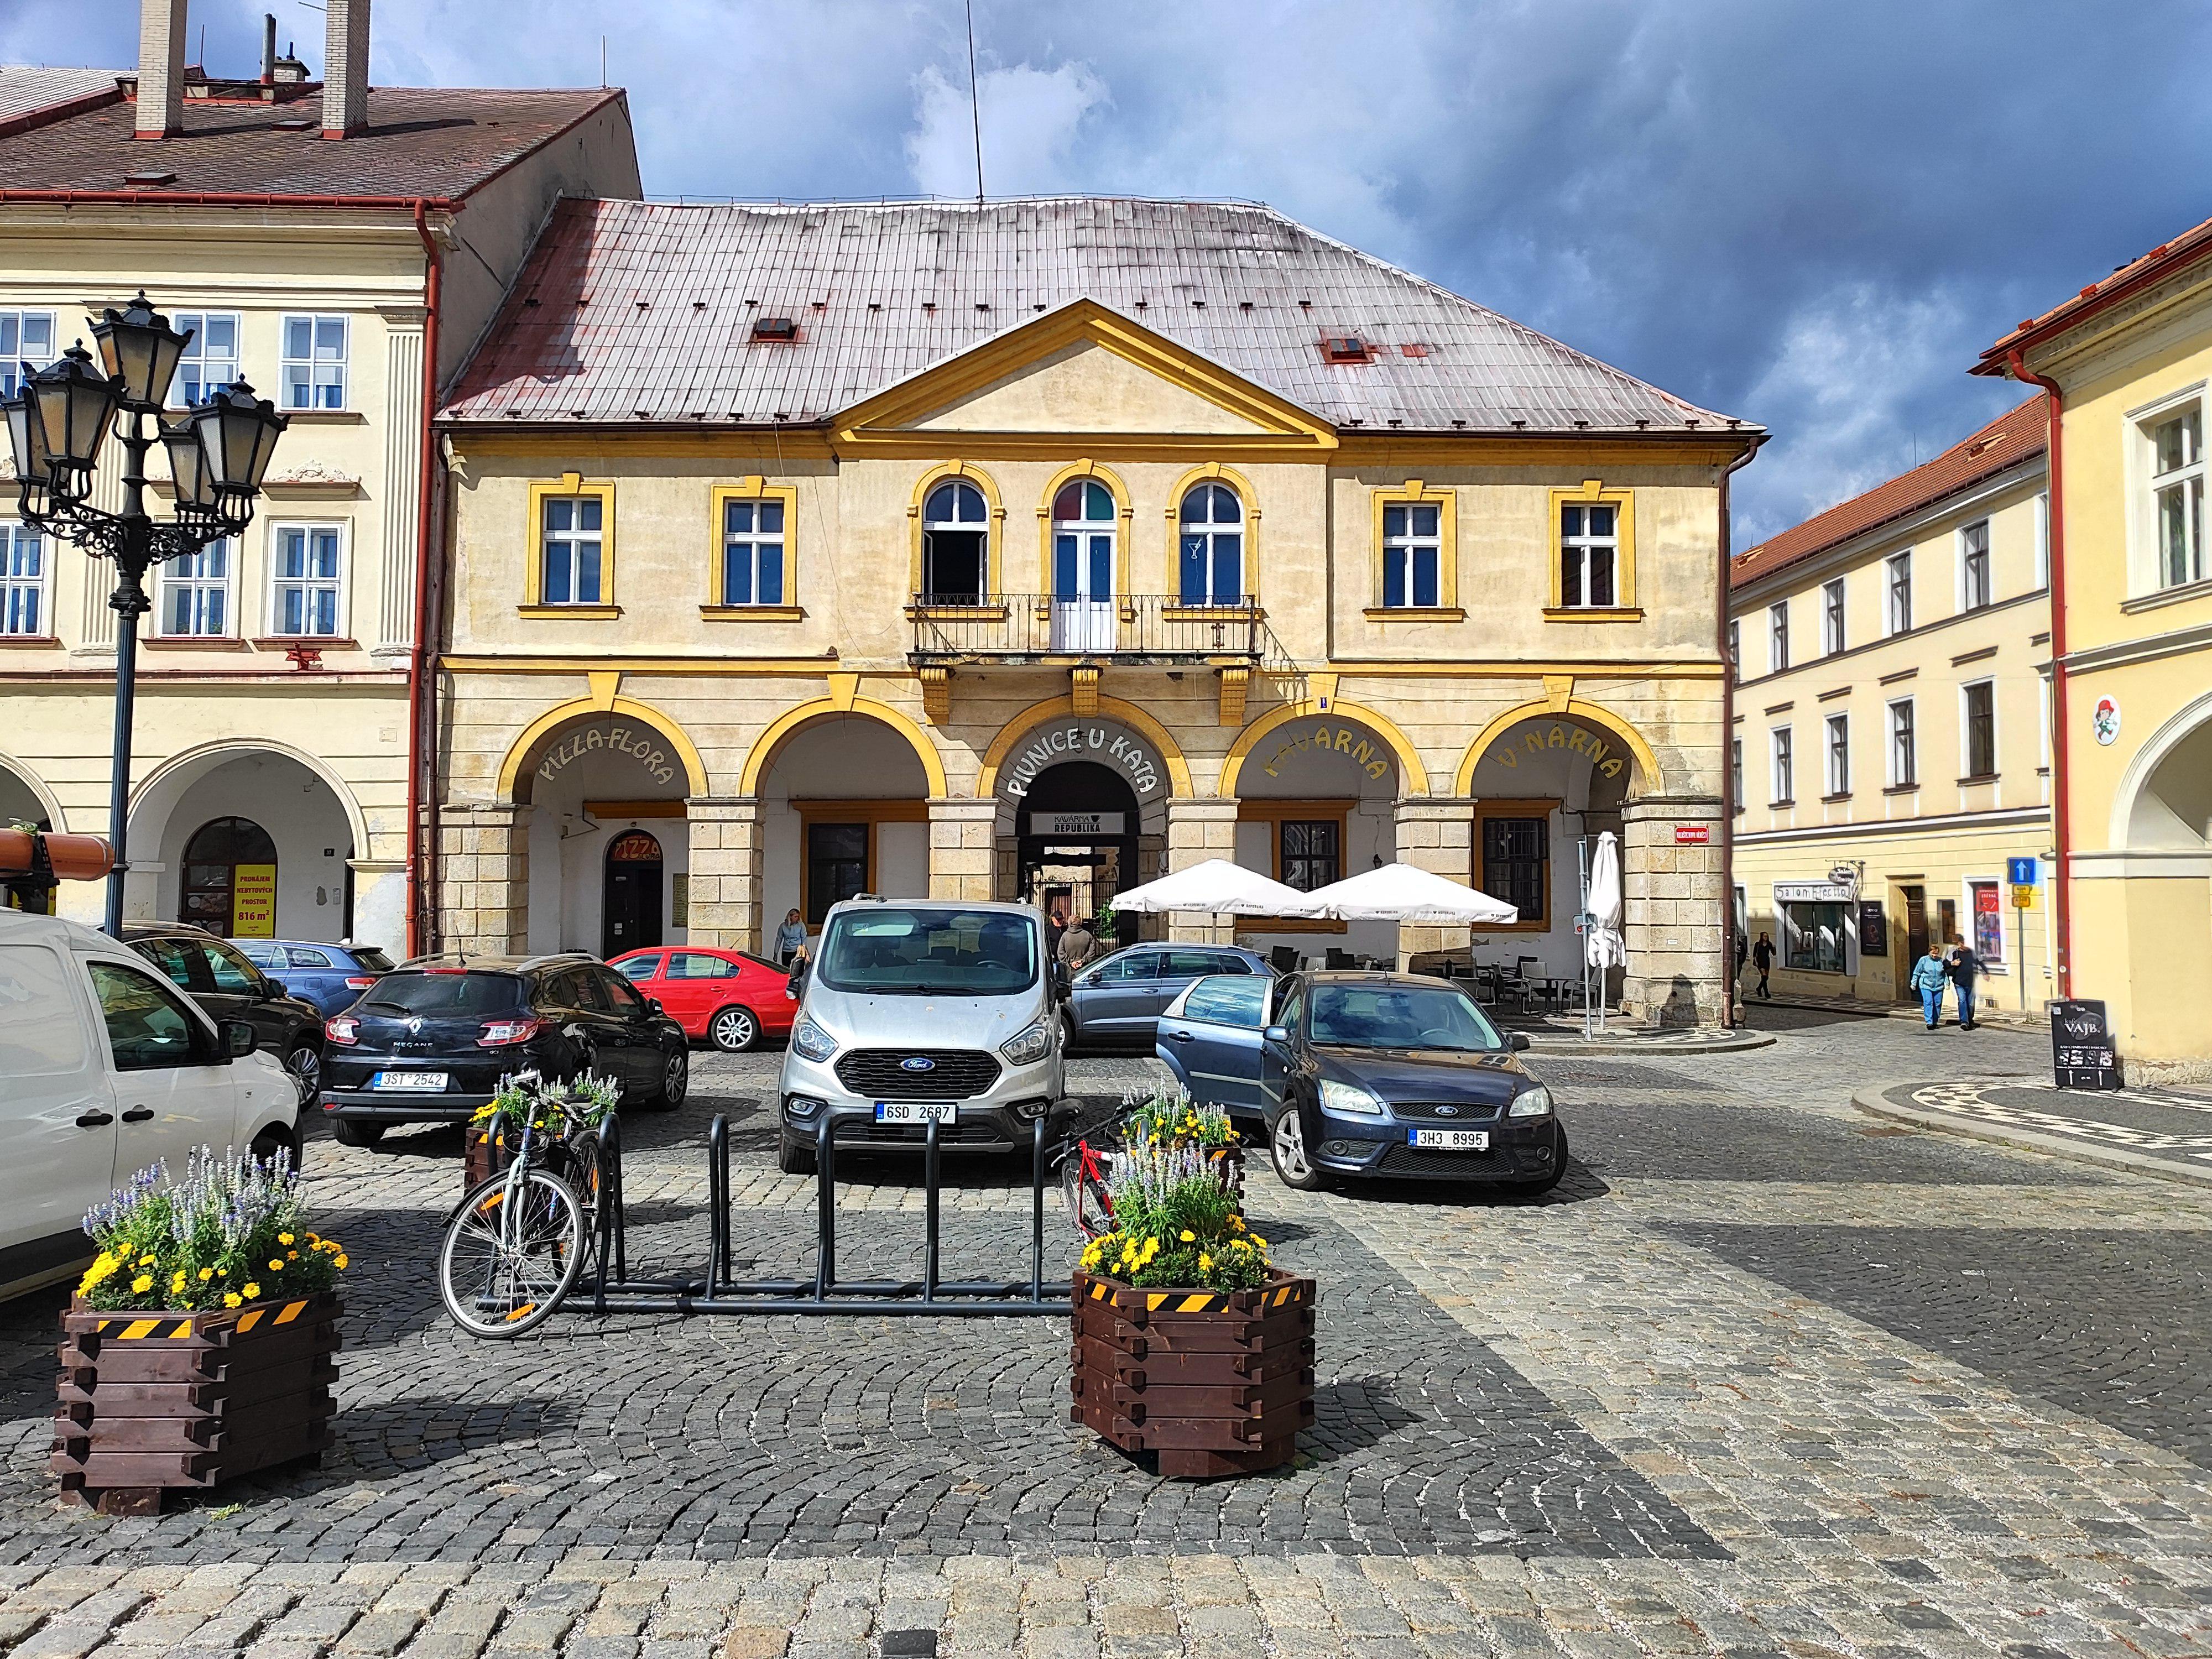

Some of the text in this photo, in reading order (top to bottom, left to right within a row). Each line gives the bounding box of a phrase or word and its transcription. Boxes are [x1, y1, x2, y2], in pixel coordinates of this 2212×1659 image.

[608, 728, 675, 785] FLORA
[1007, 728, 1158, 797] PIVNICE U KATA
[1054, 824, 1100, 833] REPUBLIKA
[614, 839, 661, 858] PIZZA
[238, 911, 255, 920] 816
[384, 1074, 442, 1086] 3ST 2542
[887, 1106, 909, 1118] 6SD
[919, 1106, 950, 1119] 2687
[1420, 1132, 1442, 1145] 3H3
[1453, 1133, 1483, 1145] 8995
